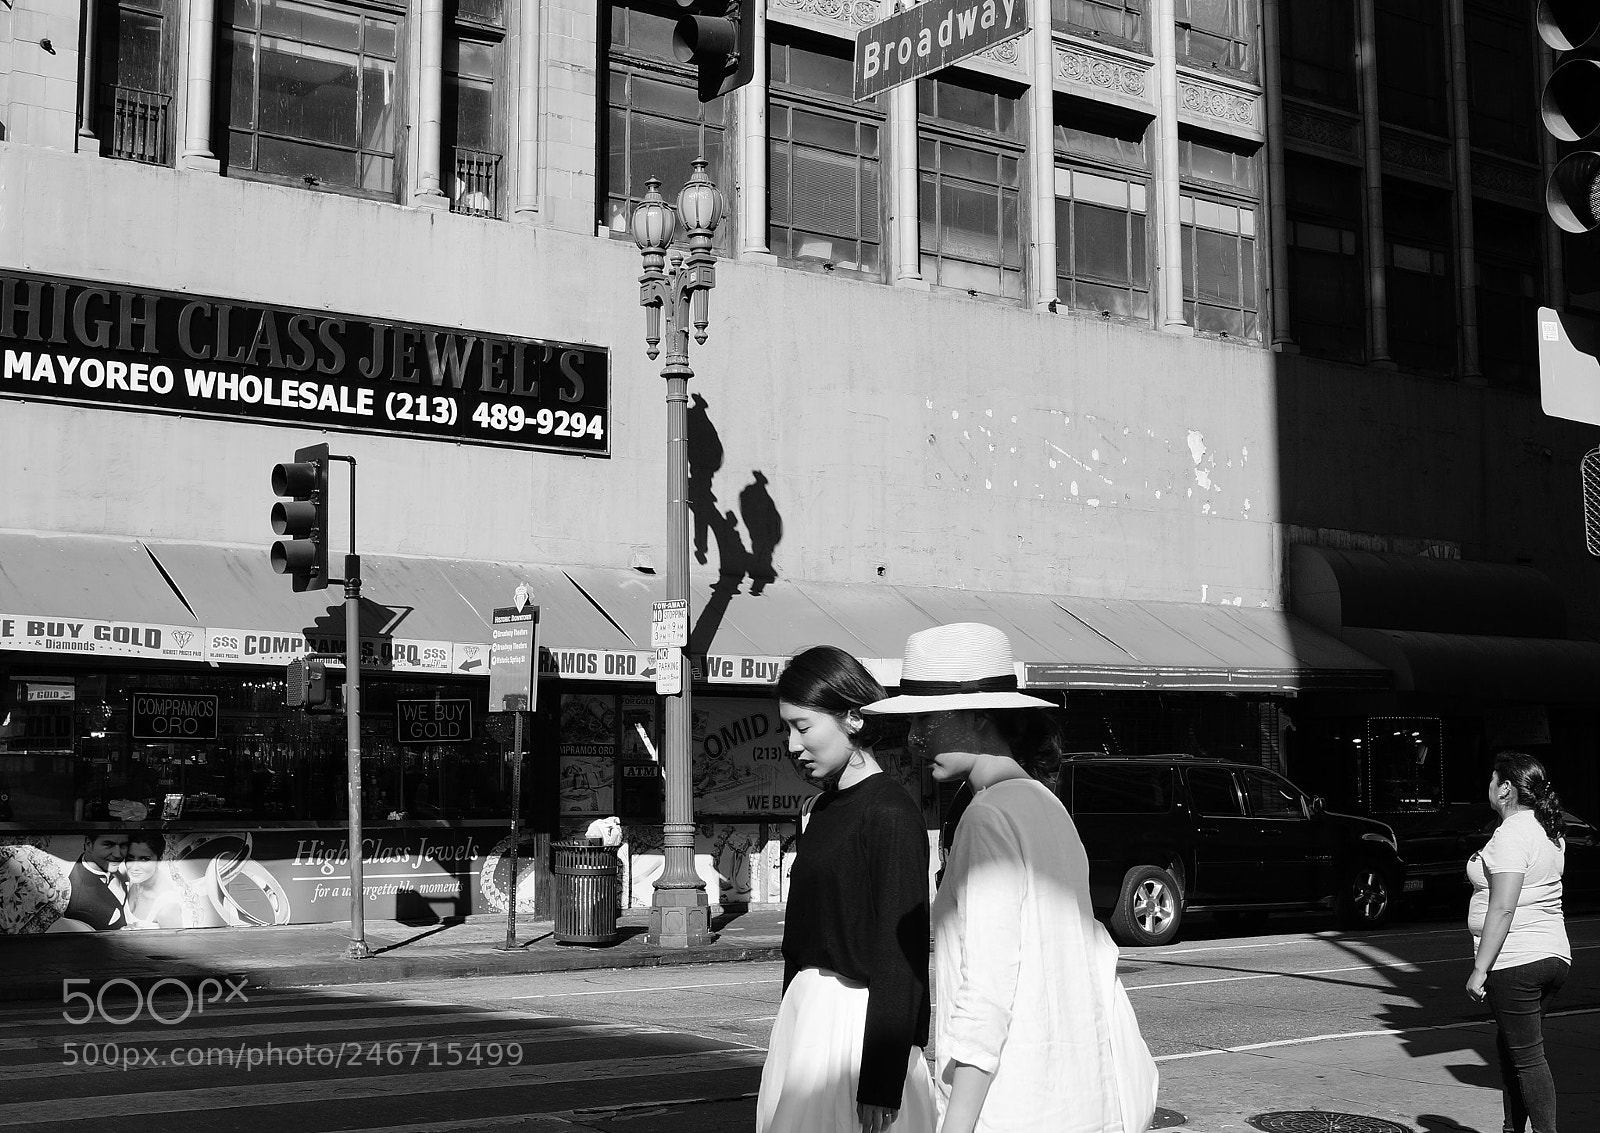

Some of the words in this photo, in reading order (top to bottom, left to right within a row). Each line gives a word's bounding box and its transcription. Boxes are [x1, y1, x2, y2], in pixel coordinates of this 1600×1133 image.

[864, 0, 1015, 79] Broadway
[0, 277, 160, 354] HIGH
[178, 301, 346, 375] CLASS
[358, 323, 585, 403] JEWEL'S
[4, 350, 175, 395] MAYOREO
[184, 368, 375, 416] WHOLESALE
[384, 391, 458, 426] (213)
[472, 402, 604, 440] 489-9294
[653, 610, 663, 621] NO
[664, 610, 685, 619] STOPPING
[27, 620, 84, 638] BUY
[93, 625, 162, 650] GOLD
[45, 639, 96, 651] Diamonds
[244, 634, 375, 657] COMPRAMS
[656, 648, 669, 660] NO
[604, 653, 637, 676] ORO
[658, 662, 679, 671] PARKING
[700, 656, 734, 678] We
[740, 658, 779, 682] Buy
[137, 697, 214, 717] COMPRAMOS
[402, 704, 428, 721] WE
[433, 704, 466, 721] BUY
[152, 716, 198, 734] ORO
[409, 720, 461, 738] GOLD
[704, 713, 769, 759] OMID
[598, 746, 614, 755] ORO
[752, 746, 782, 762] (213)
[626, 767, 656, 776] ATM
[747, 795, 769, 809] WE
[772, 795, 801, 808] BUY
[292, 839, 348, 874] High
[411, 836, 479, 869] Jewels
[310, 883, 331, 903] for
[332, 887, 339, 896] a
